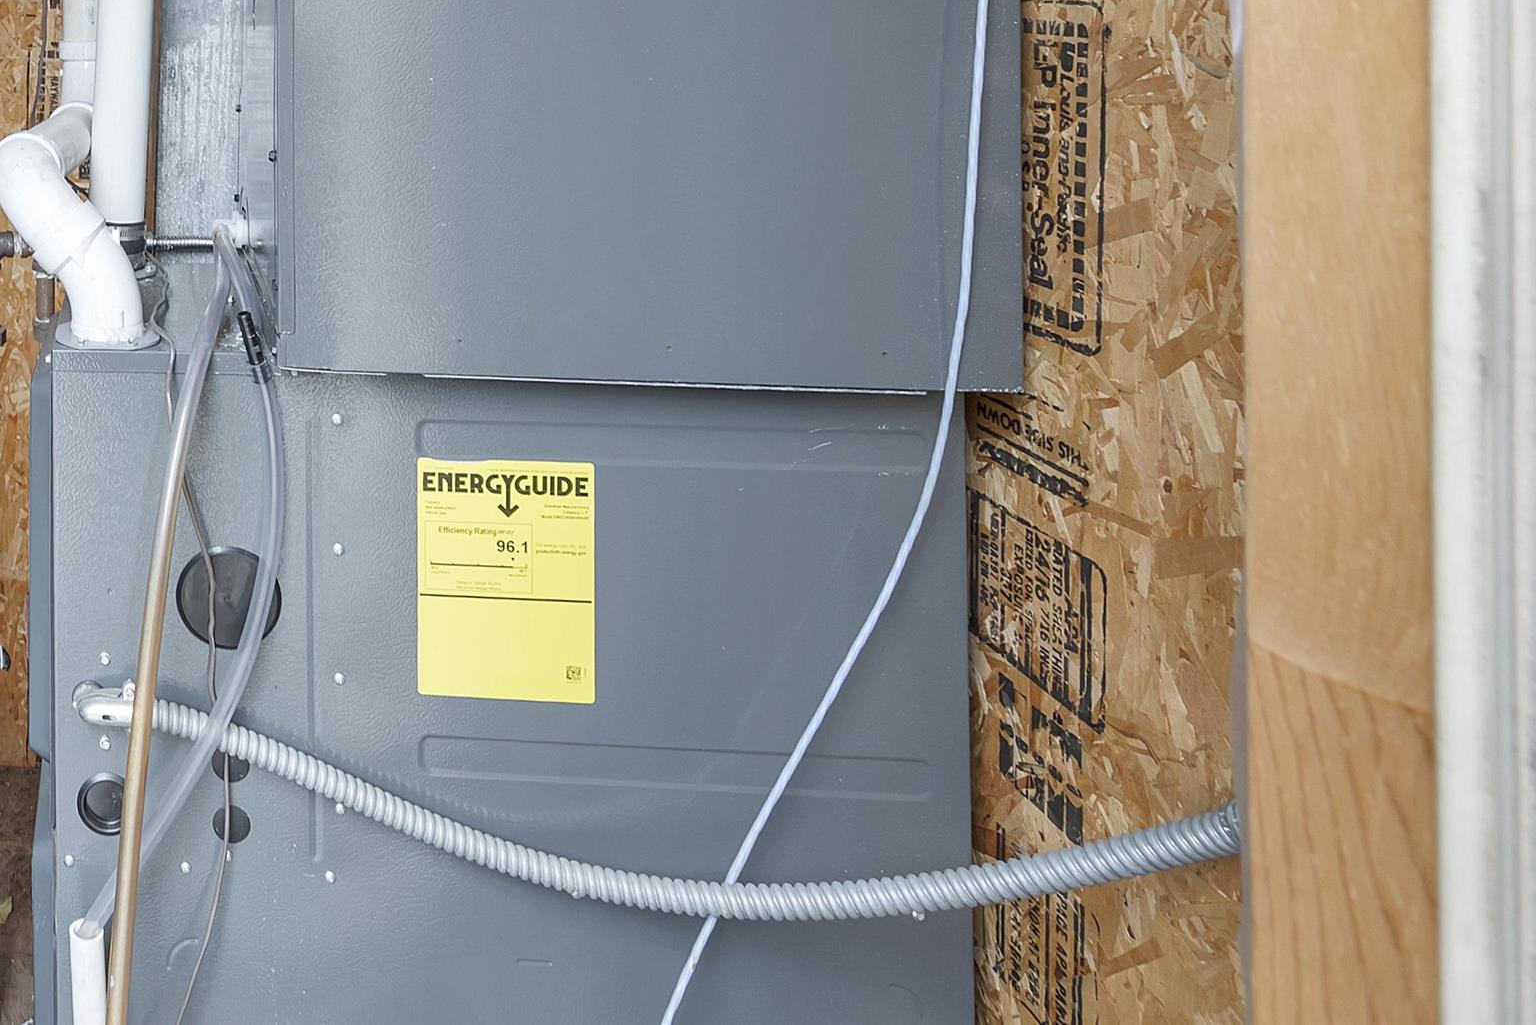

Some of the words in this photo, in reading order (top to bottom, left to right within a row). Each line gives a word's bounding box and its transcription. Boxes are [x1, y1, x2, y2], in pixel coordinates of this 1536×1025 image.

[50, 76, 60, 117] HAYWA
[1056, 72, 1074, 254] Louisana-Pacific
[1028, 100, 1056, 290] Inner-Seal
[976, 402, 1021, 435] DOWN
[1058, 440, 1089, 472] THIS
[423, 472, 589, 498] ENERGYGUIDE
[438, 526, 473, 536] Efficiency
[474, 527, 497, 537] Rating
[496, 540, 528, 553] 96.1
[1034, 532, 1052, 604] 24/16
[1052, 539, 1064, 597] RATED
[1024, 575, 1034, 604] FOR
[1039, 607, 1050, 642] 7/16
[1064, 596, 1079, 656] APA
[1051, 603, 1064, 691] SHEATHIN
